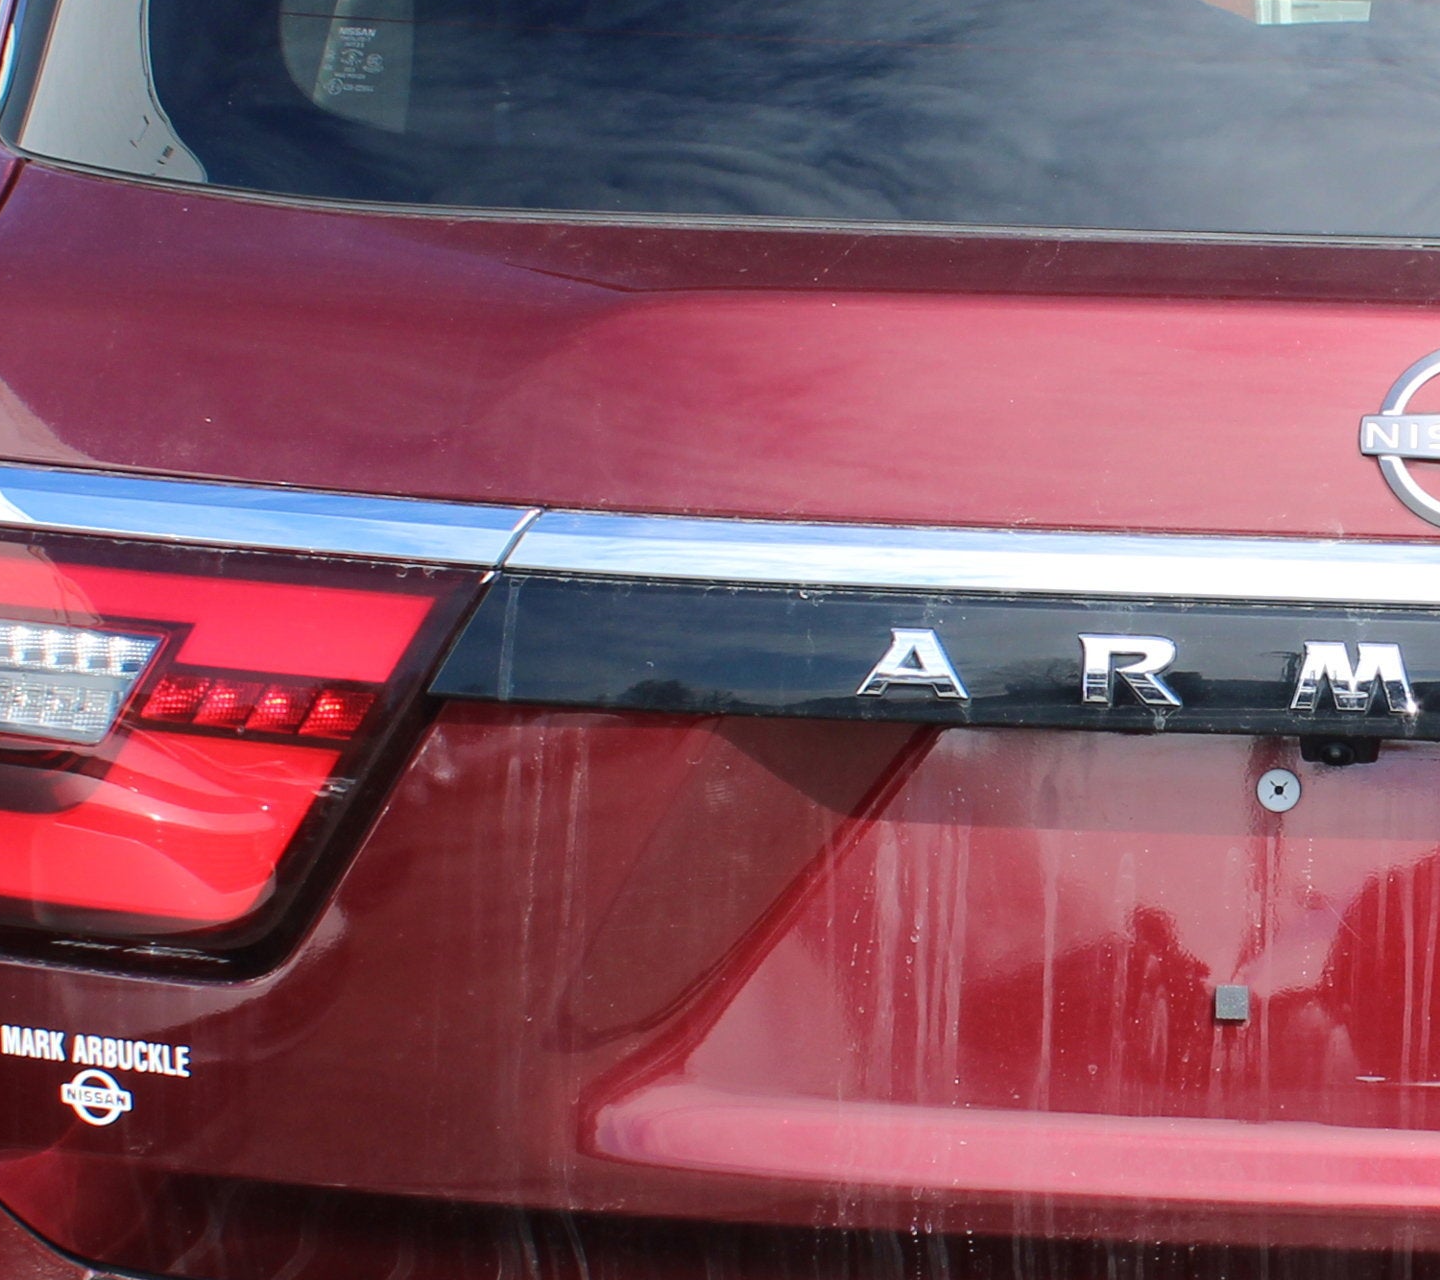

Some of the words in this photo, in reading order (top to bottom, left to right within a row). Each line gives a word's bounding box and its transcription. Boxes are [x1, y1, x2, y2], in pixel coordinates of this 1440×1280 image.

[339, 26, 377, 37] NISSAN
[0, 1024, 66, 1062] MARK
[72, 1034, 192, 1078] ARBUCKLE
[66, 1087, 127, 1108] NISSAN
